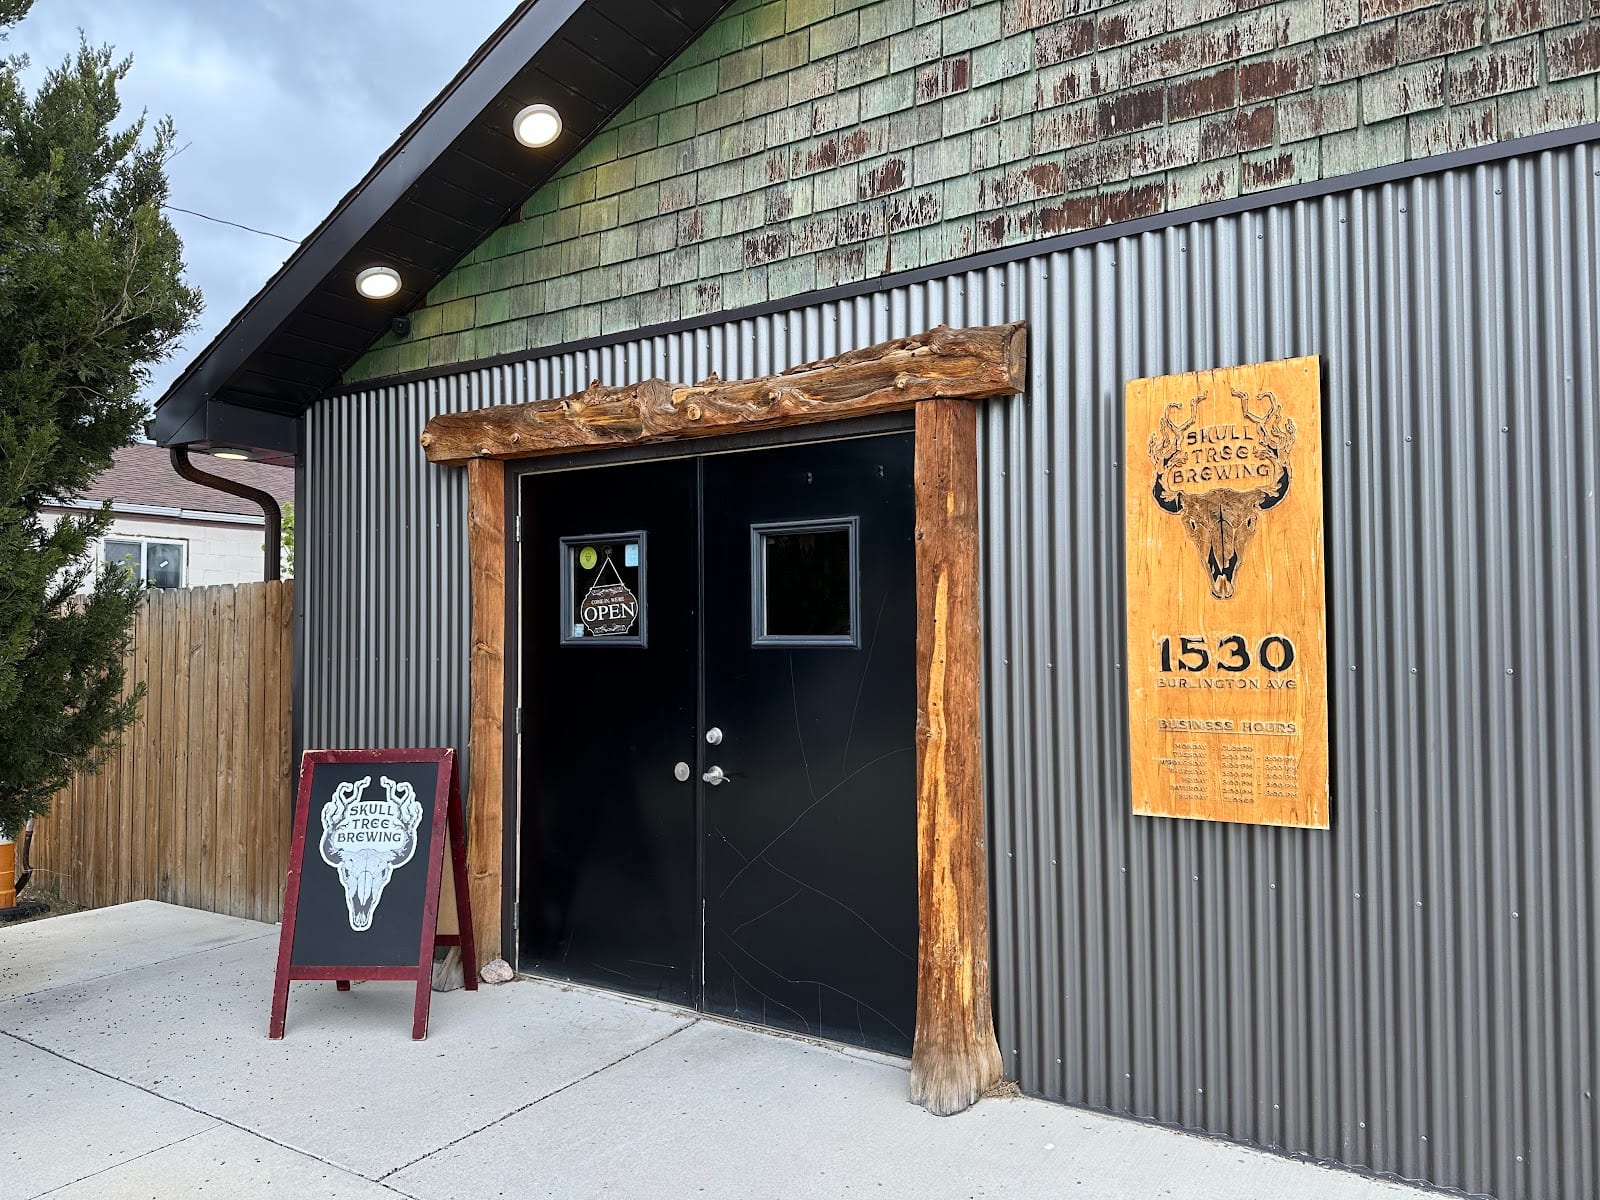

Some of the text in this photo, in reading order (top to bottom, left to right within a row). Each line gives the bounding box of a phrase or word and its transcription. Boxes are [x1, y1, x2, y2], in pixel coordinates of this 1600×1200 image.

[1187, 425, 1254, 445] SKULL
[1192, 446, 1249, 463] TREE
[1173, 465, 1270, 484] BREWING
[584, 602, 635, 621] OPEN
[1159, 635, 1294, 672] 1530
[1157, 678, 1296, 689] BURLINGTON AVE
[1159, 720, 1296, 734] BUSINESS HOURS
[350, 804, 394, 816] SKULL
[352, 819, 390, 829] TREE
[337, 831, 401, 843] BREWING
